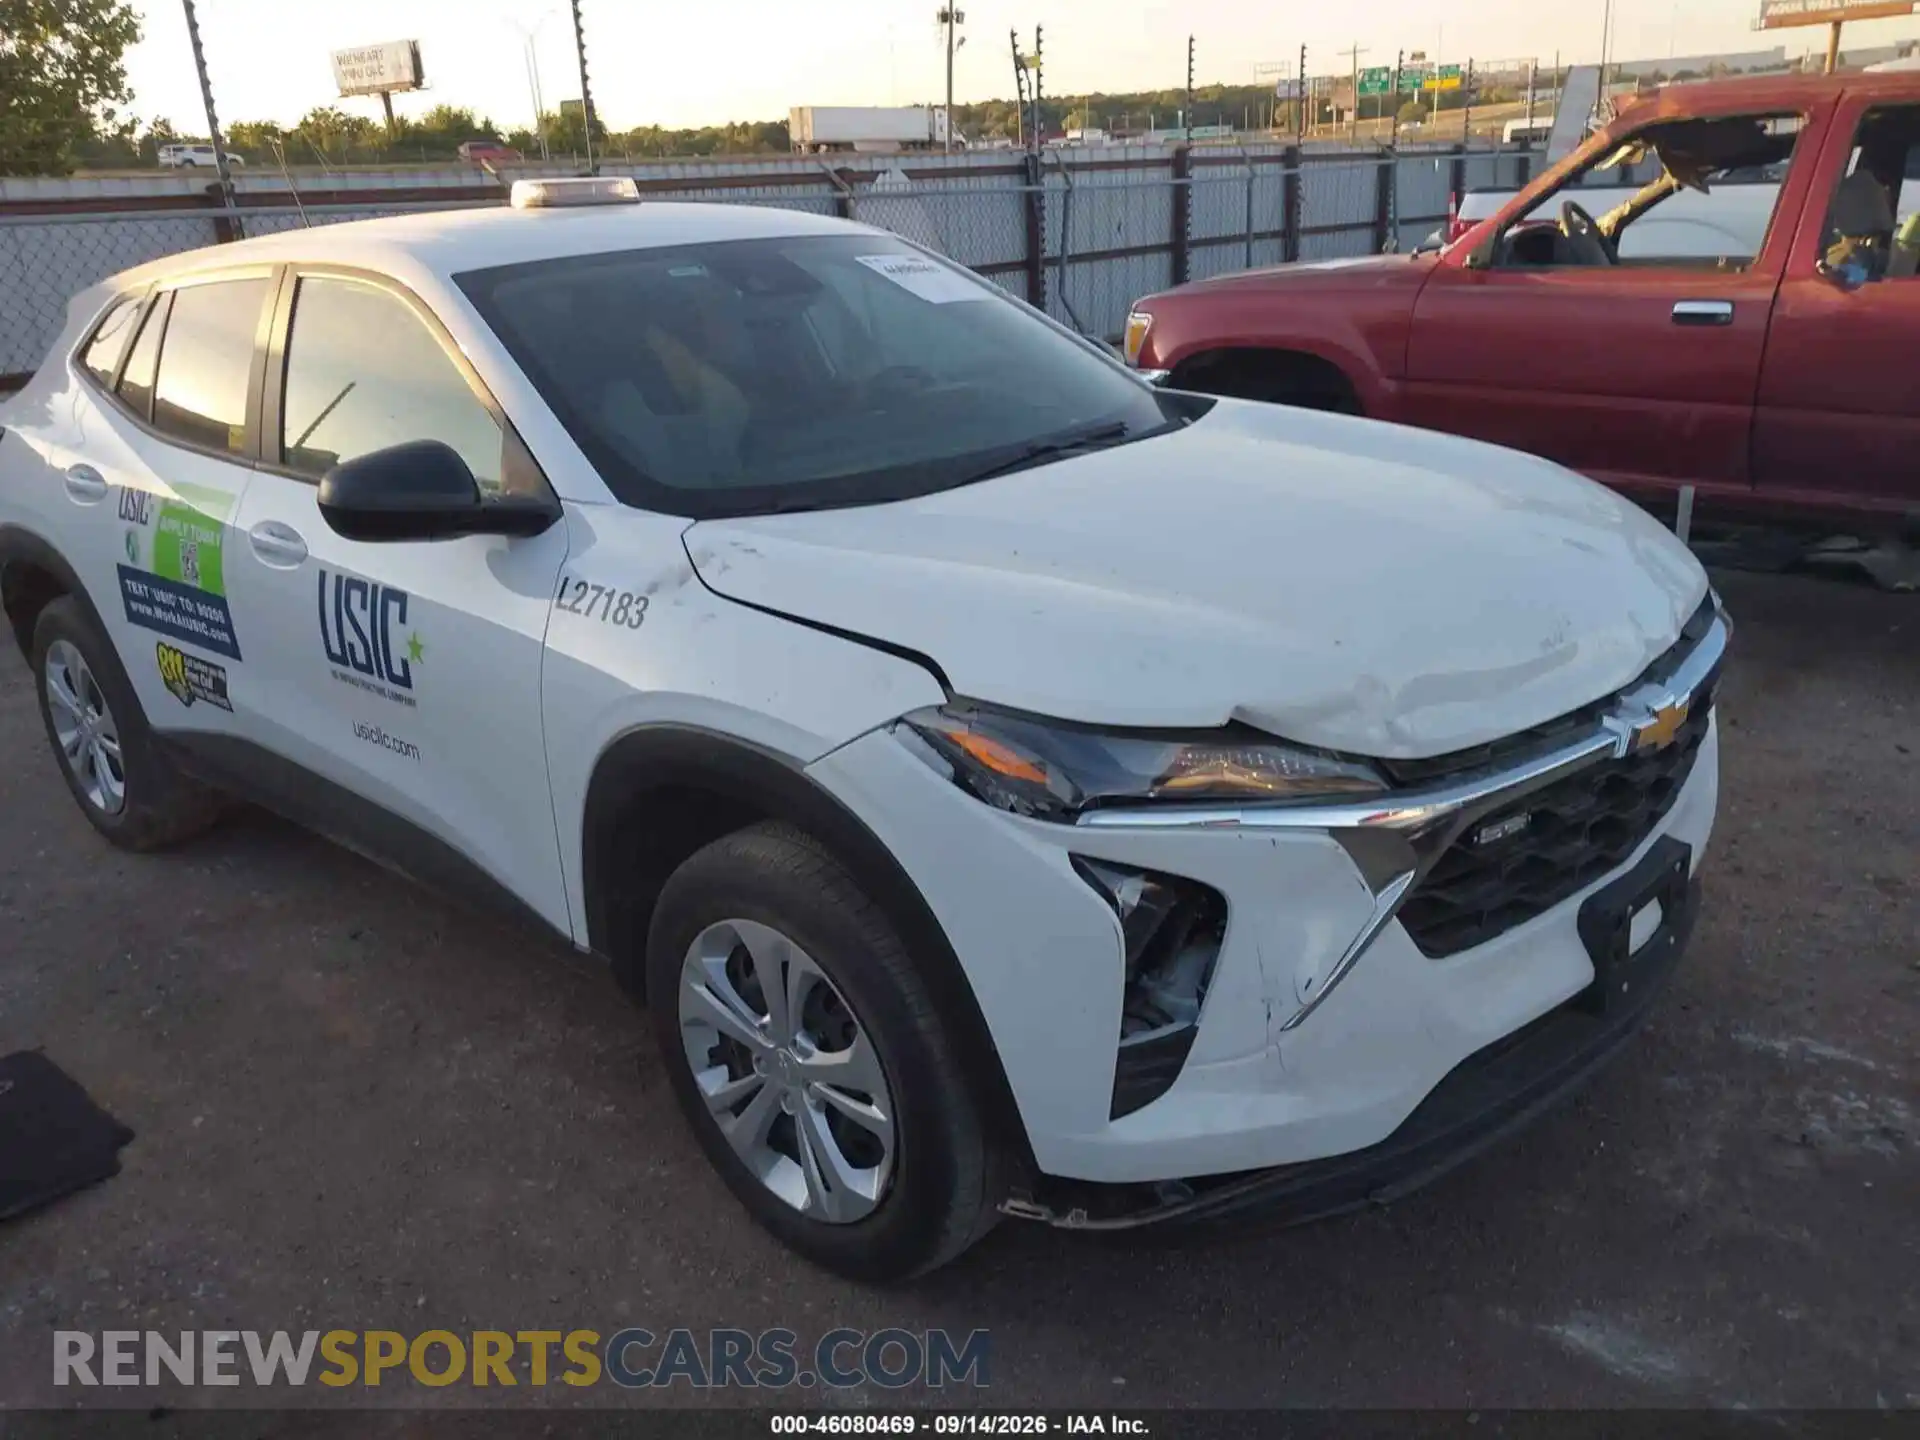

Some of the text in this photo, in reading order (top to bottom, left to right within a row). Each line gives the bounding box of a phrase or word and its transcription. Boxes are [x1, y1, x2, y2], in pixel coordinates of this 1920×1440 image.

[118, 485, 150, 526] USIC
[125, 578, 150, 599] TEXT
[556, 576, 649, 630] L27183
[318, 569, 413, 690] USIC
[352, 719, 421, 761] usicllc.com
